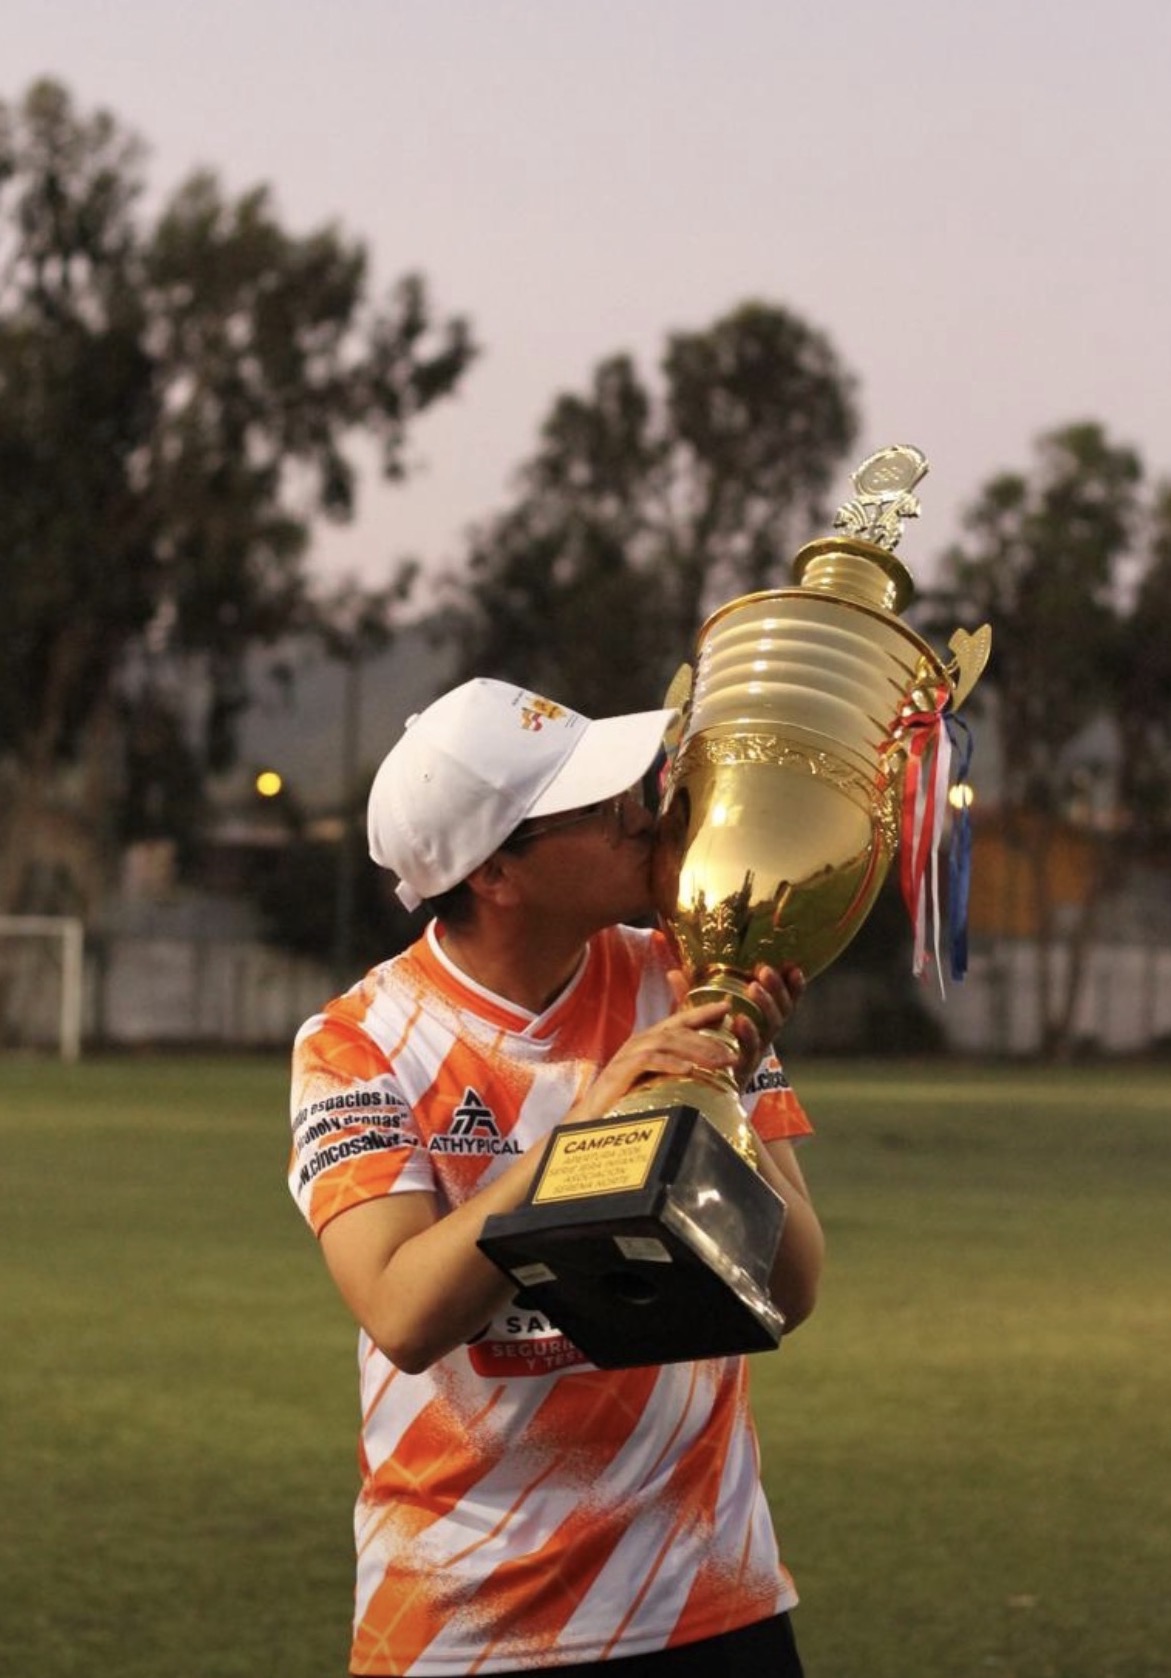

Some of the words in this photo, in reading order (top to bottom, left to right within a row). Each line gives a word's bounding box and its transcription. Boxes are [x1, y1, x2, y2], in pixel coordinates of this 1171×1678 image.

[311, 1091, 381, 1116] espacios
[330, 1116, 342, 1130] y
[430, 1137, 524, 1154] ATHYPICAL
[526, 1359, 537, 1371] Y
